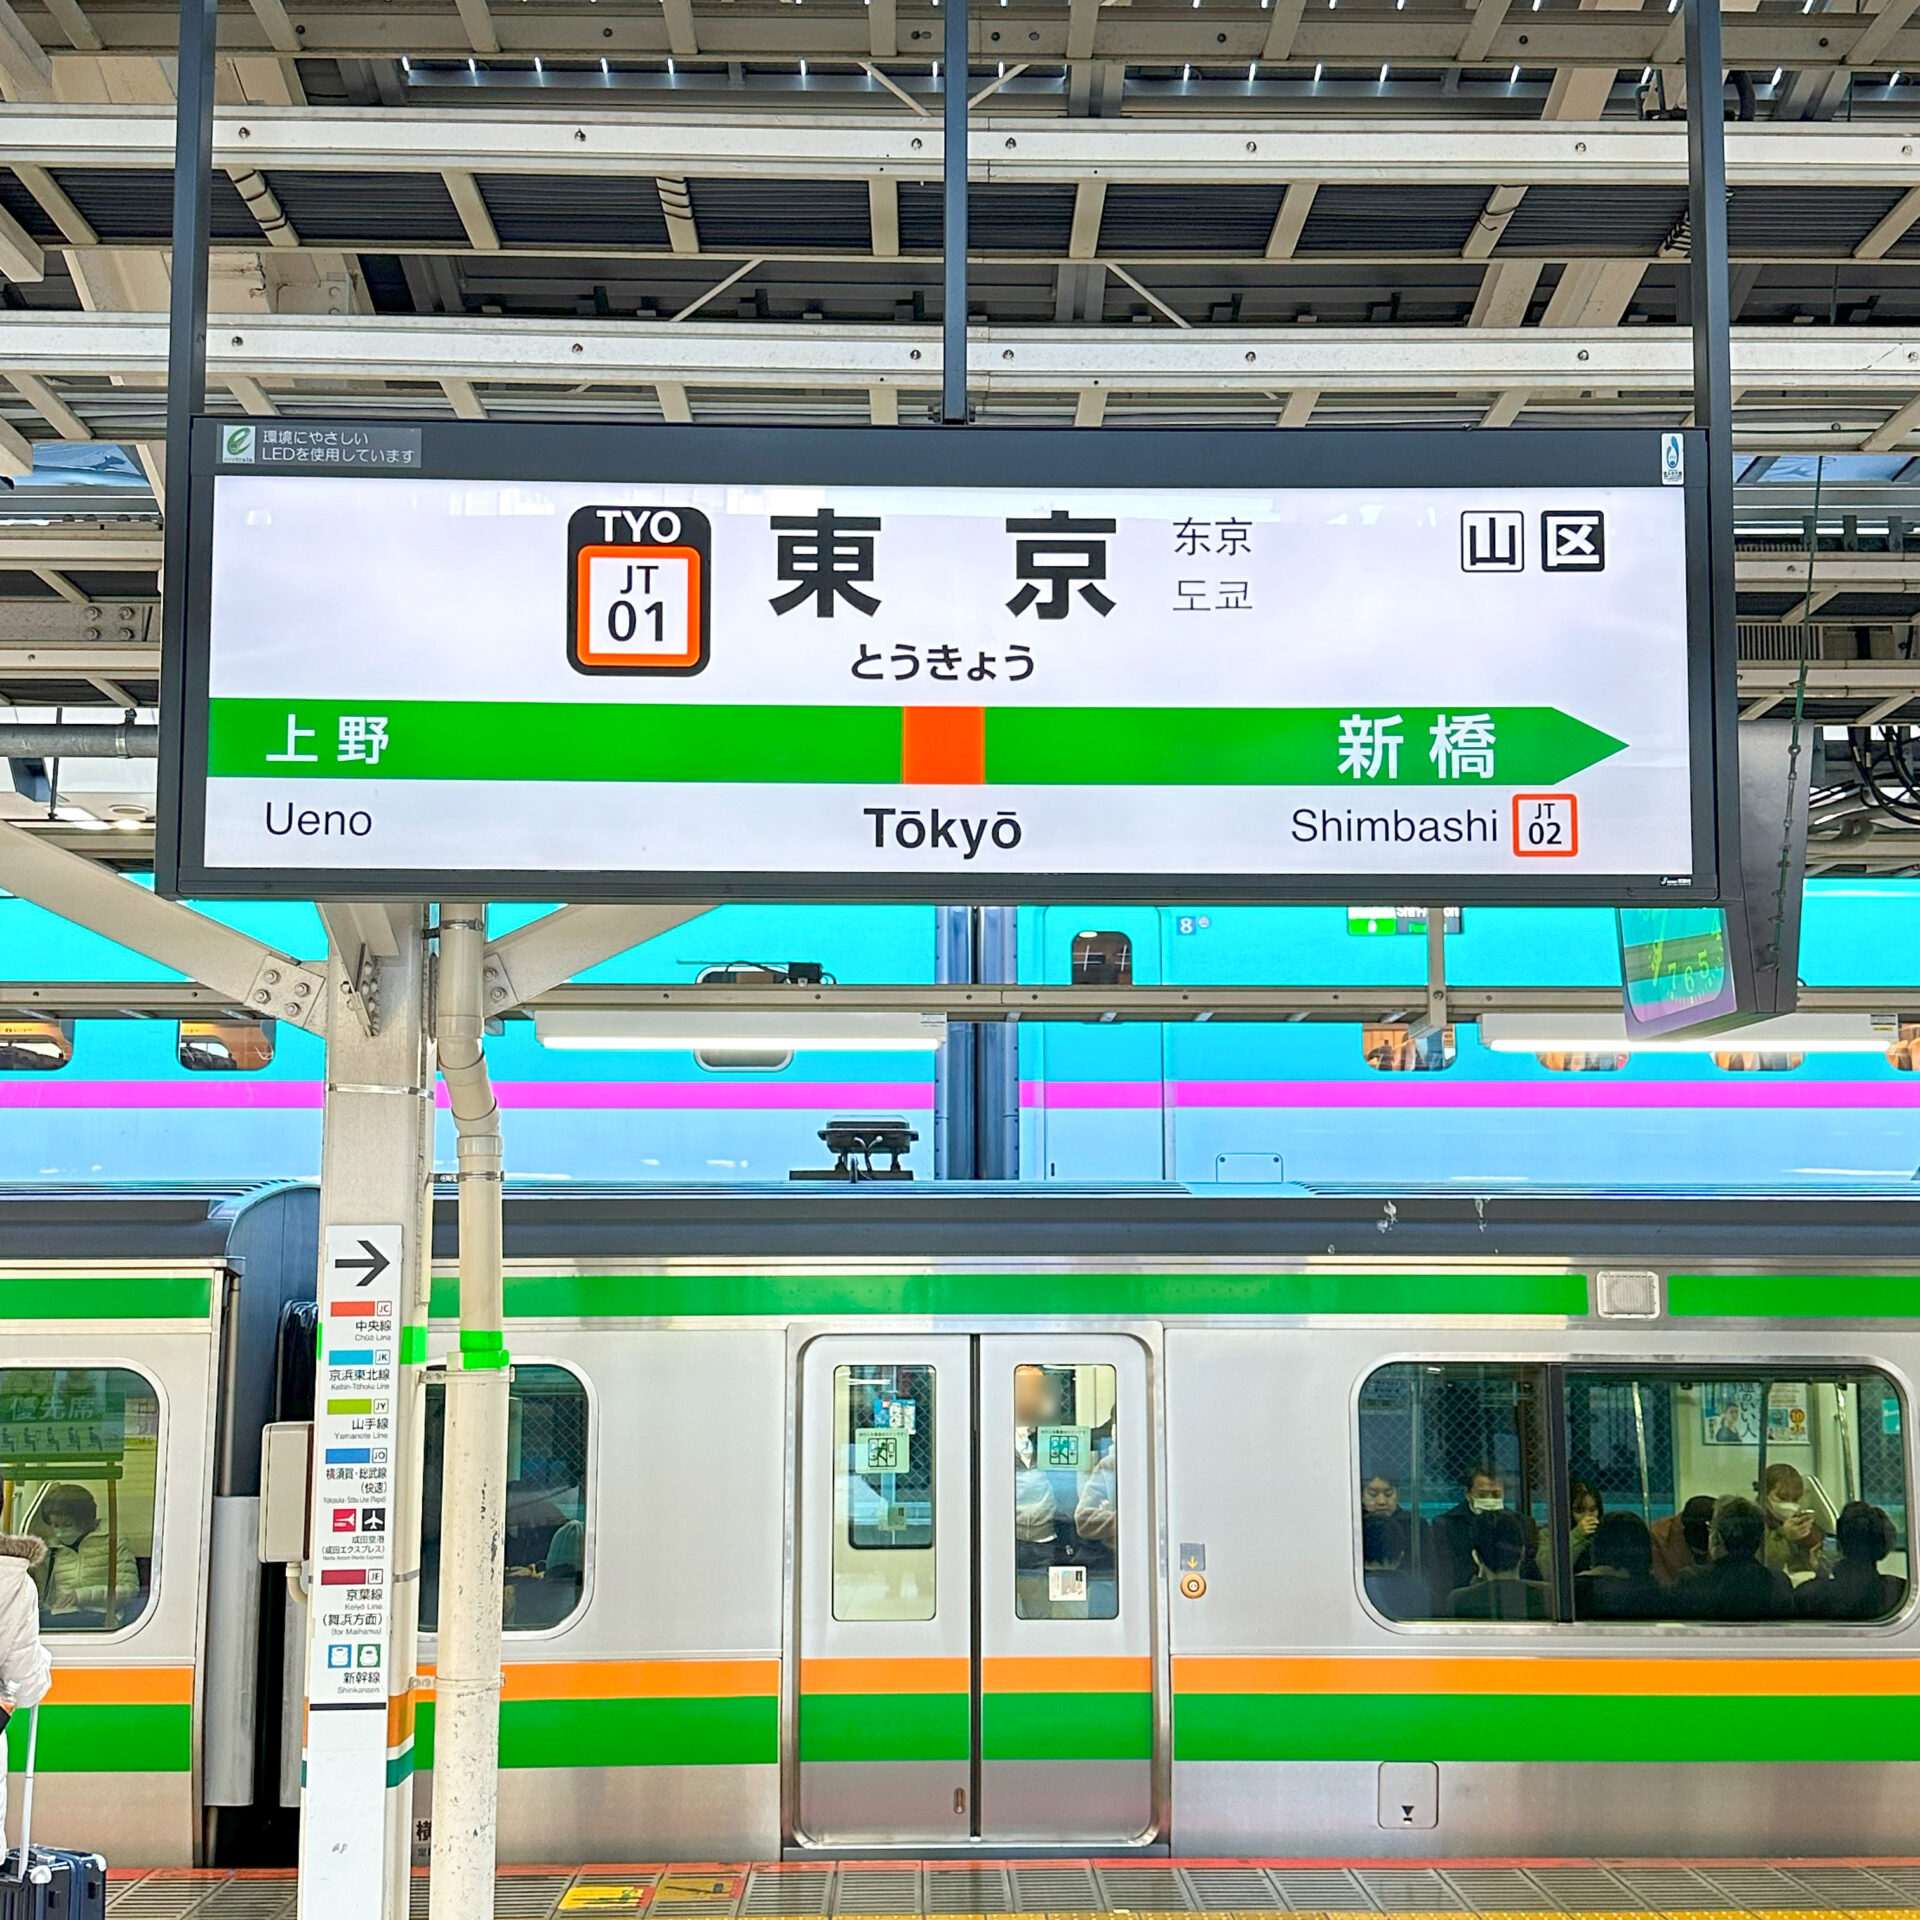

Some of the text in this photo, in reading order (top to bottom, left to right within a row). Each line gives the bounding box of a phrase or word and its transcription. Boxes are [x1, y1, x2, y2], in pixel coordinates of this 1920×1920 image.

[262, 430, 368, 445] 環境にやさしい
[262, 447, 415, 464] LEDを使用しています
[596, 510, 682, 544] TYO
[1172, 517, 1253, 556] 东京
[1471, 515, 1599, 567] 山 区
[768, 507, 1117, 621] 東京
[620, 565, 660, 595] JT
[1172, 580, 1253, 613] 도쿄
[607, 601, 666, 643] 01
[850, 643, 1036, 681] とうきょう
[266, 714, 389, 765] 上野
[1337, 713, 1497, 780] 新橋
[265, 802, 372, 837] Ueno
[1533, 803, 1555, 819] JT
[864, 807, 1023, 859] Tōkyō
[1291, 807, 1499, 846] Shimbashi
[1527, 822, 1562, 847] 02
[1180, 917, 1193, 934] 8
[1698, 949, 1710, 979] 5
[1667, 962, 1678, 990] 7
[1684, 965, 1695, 993] 6
[379, 1304, 390, 1313] JC
[355, 1320, 392, 1332] 中央線
[377, 1353, 388, 1361] JK
[329, 1369, 390, 1381] 京浜東北線
[10, 1395, 95, 1421] 優先席
[376, 1402, 386, 1411] JY
[352, 1417, 388, 1430] 山手線
[334, 1432, 371, 1440] Yamanote
[374, 1451, 386, 1459] JO
[352, 1535, 385, 1544] 成田空港
[371, 1572, 380, 1580] JE
[346, 1588, 383, 1601] 京葉線
[331, 1628, 344, 1636] (for
[343, 1671, 381, 1684] 新幹線
[337, 1686, 380, 1694] Shinkansen
